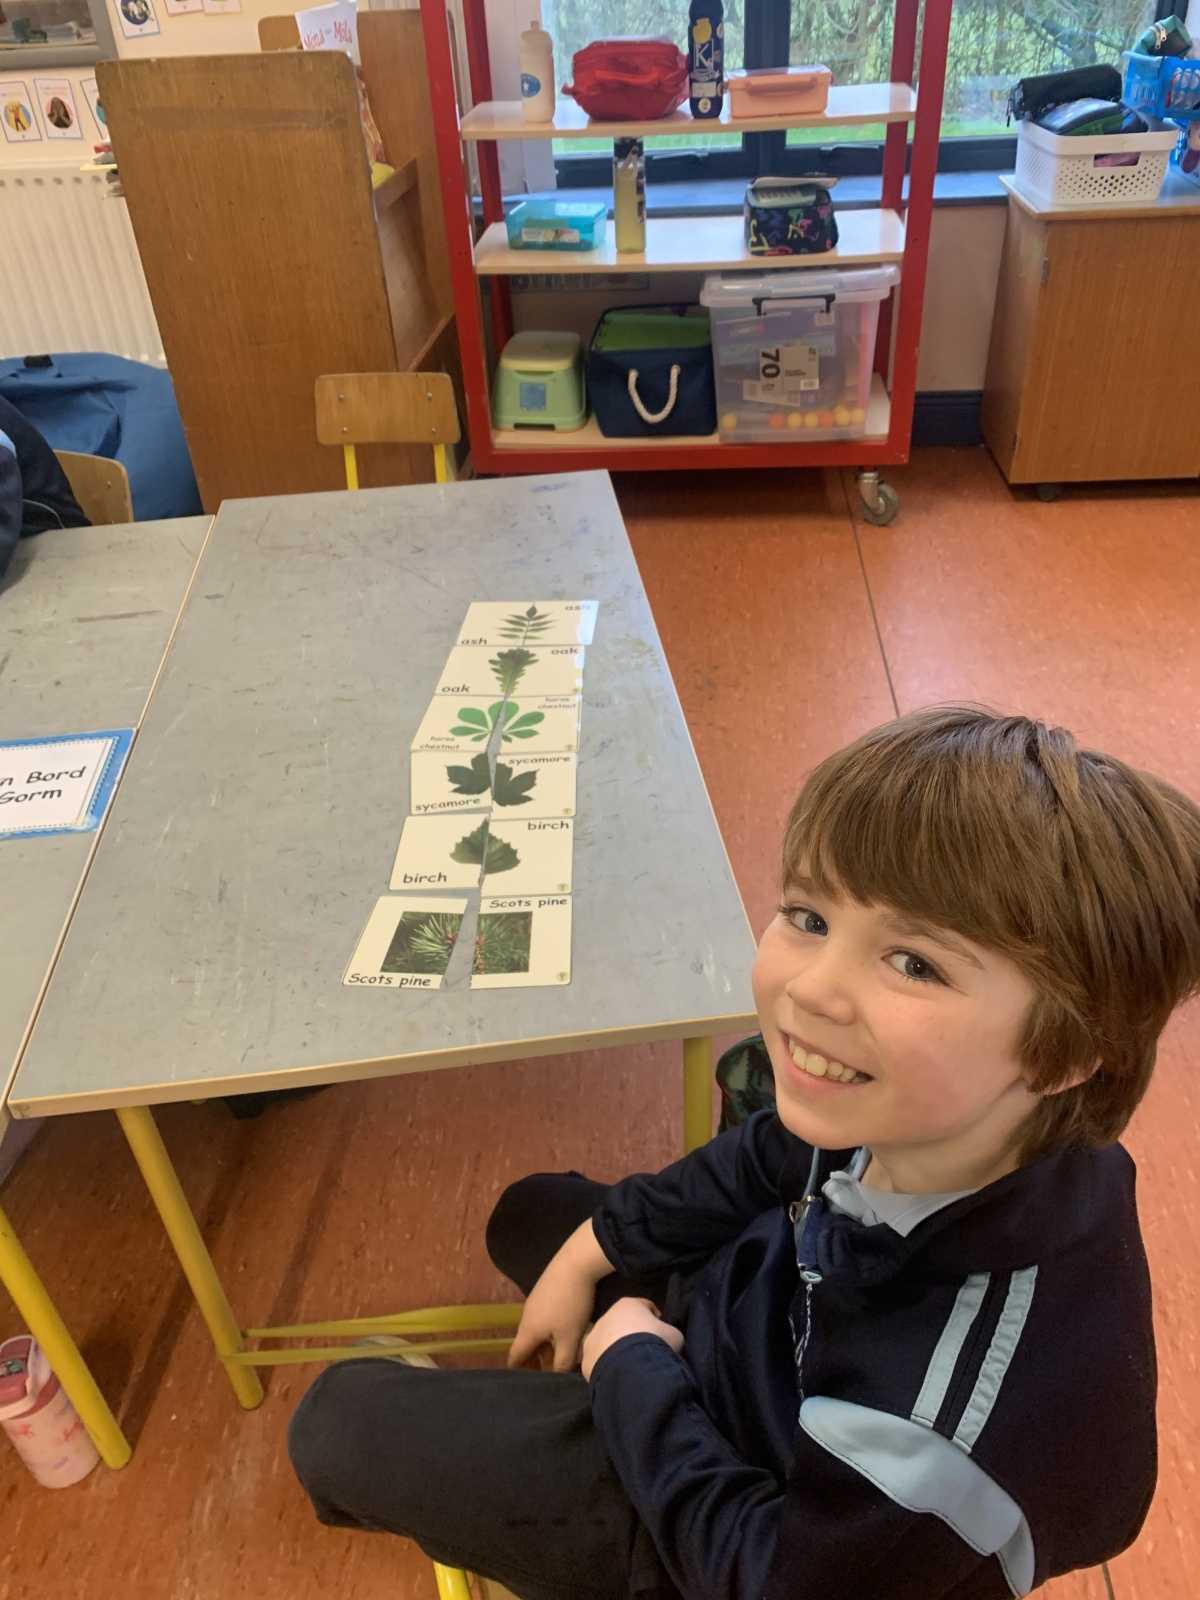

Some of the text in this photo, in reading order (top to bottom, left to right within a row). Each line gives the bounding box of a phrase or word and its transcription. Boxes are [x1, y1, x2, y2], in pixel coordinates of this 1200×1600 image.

[761, 348, 781, 378] 70
[461, 637, 487, 646] ash
[551, 647, 579, 655] oak
[441, 684, 471, 693] oak
[419, 742, 460, 751] chestnut
[508, 755, 572, 766] sycamore
[26, 765, 87, 785] Bord
[415, 797, 481, 812] sycamore
[527, 820, 570, 831] birch
[402, 871, 447, 884] birch
[488, 896, 569, 909] Scots pine
[347, 973, 432, 989] Scots pine
